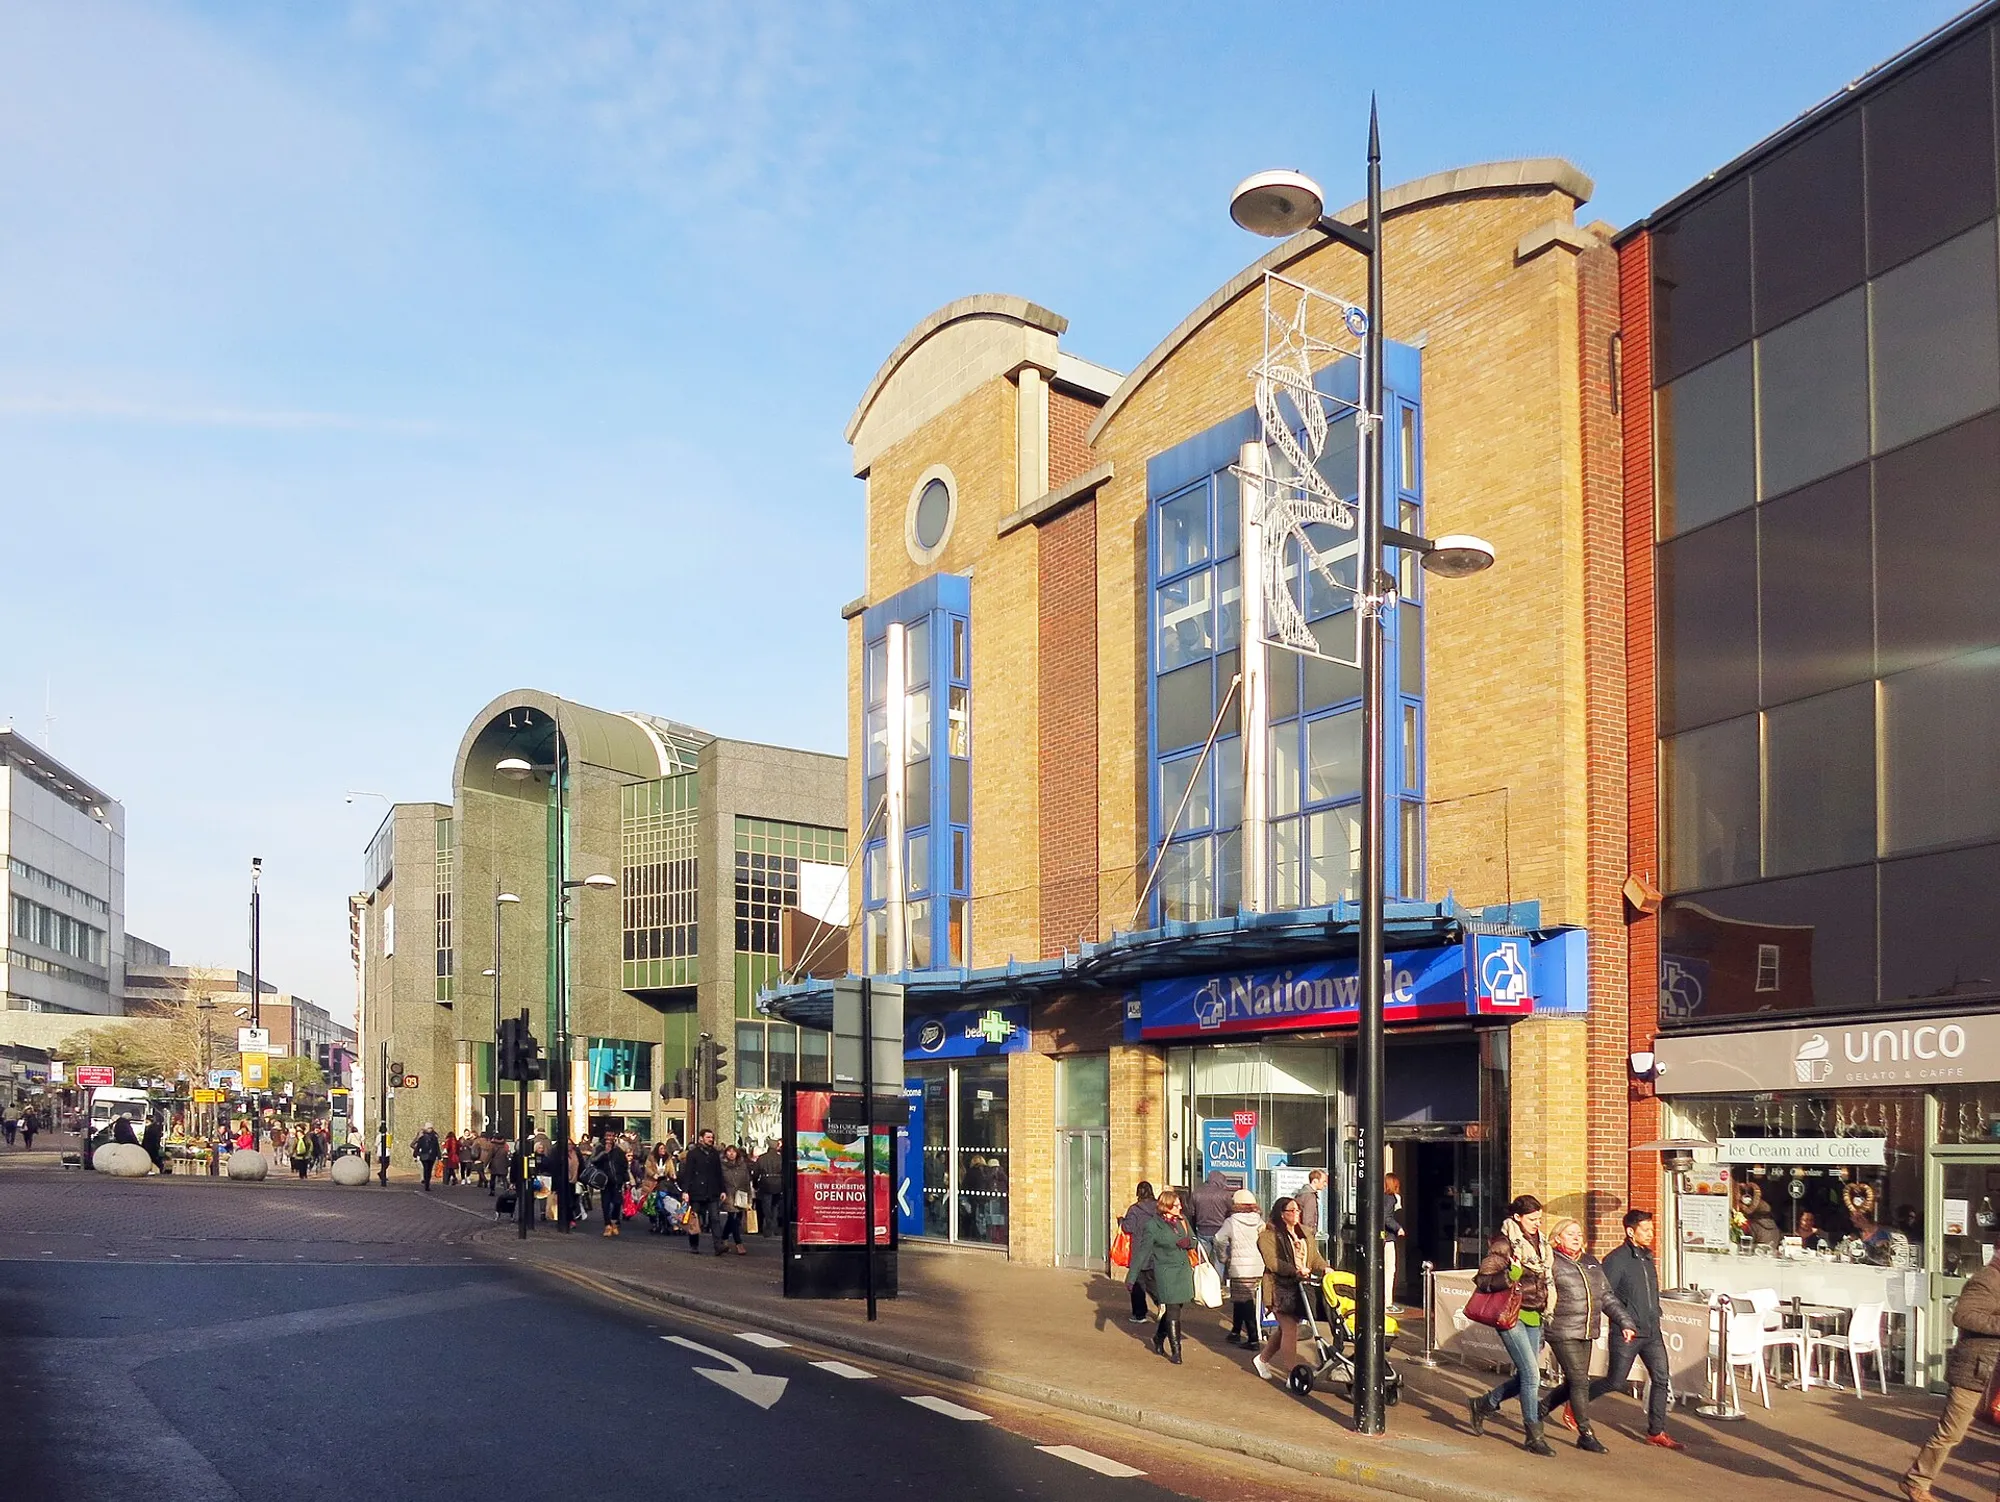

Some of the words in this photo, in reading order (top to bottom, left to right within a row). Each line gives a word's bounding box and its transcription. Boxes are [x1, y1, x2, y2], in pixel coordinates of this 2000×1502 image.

[1228, 959, 1414, 1017] Nationwe
[1844, 1024, 1965, 1063] UNICO
[1846, 1071, 1896, 1081] GELATO
[1904, 1070, 1912, 1079] &
[1235, 1113, 1253, 1126] FREE
[1209, 1141, 1246, 1160] CASH
[1728, 1143, 1745, 1157] Ice
[1750, 1143, 1791, 1157] Cream
[1795, 1143, 1820, 1157] and
[1829, 1143, 1871, 1158] Coffee
[1211, 1160, 1246, 1168] WITHDRAWALS
[831, 1183, 866, 1191] EXHIBITIO
[814, 1191, 843, 1201] OPEN
[1440, 1286, 1451, 1295] ICE
